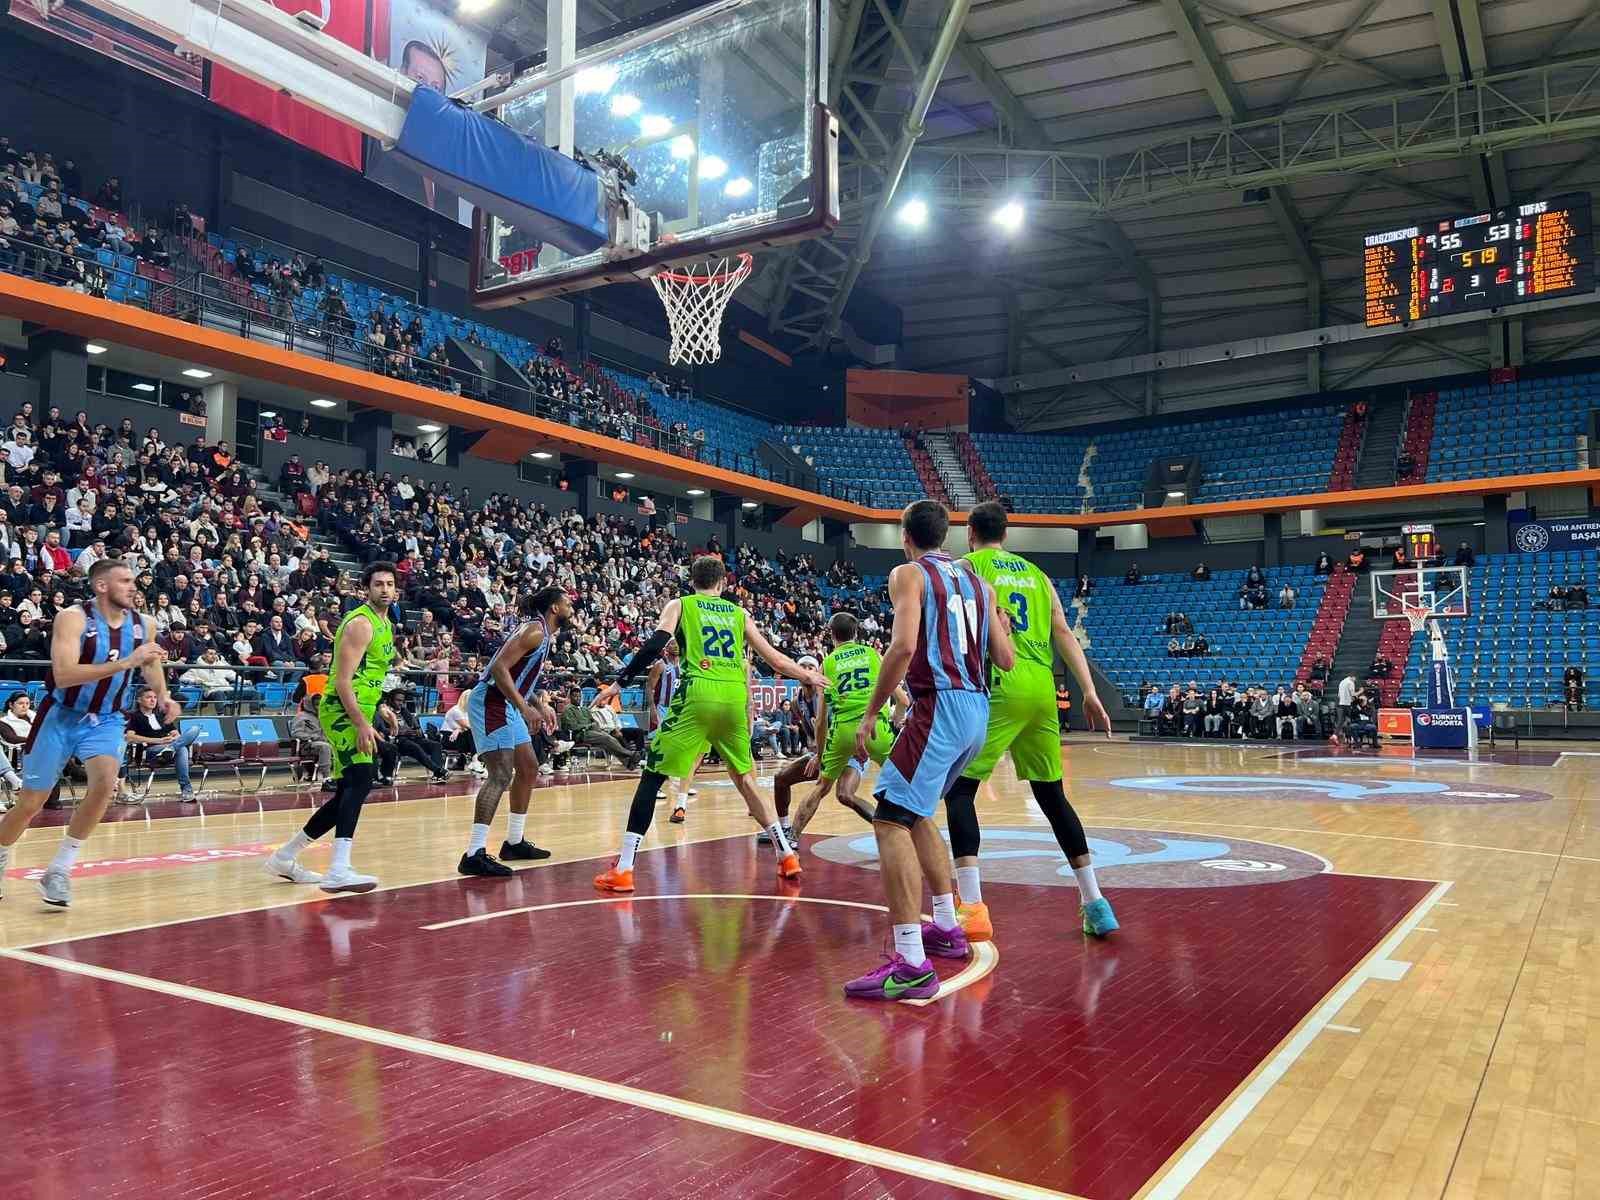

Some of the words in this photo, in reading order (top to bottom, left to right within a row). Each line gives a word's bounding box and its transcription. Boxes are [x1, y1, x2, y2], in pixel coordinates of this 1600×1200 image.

[1364, 227, 1419, 247] TRABZONSPOR
[1441, 233, 1461, 250] 55
[1489, 223, 1510, 241] 53
[1462, 251, 1472, 267] 5
[1481, 247, 1495, 264] 19
[1470, 275, 1479, 287] 3
[1570, 523, 1600, 531] ANTREN
[1008, 591, 1028, 632] 3
[702, 625, 735, 658] 22
[837, 667, 870, 695] 25
